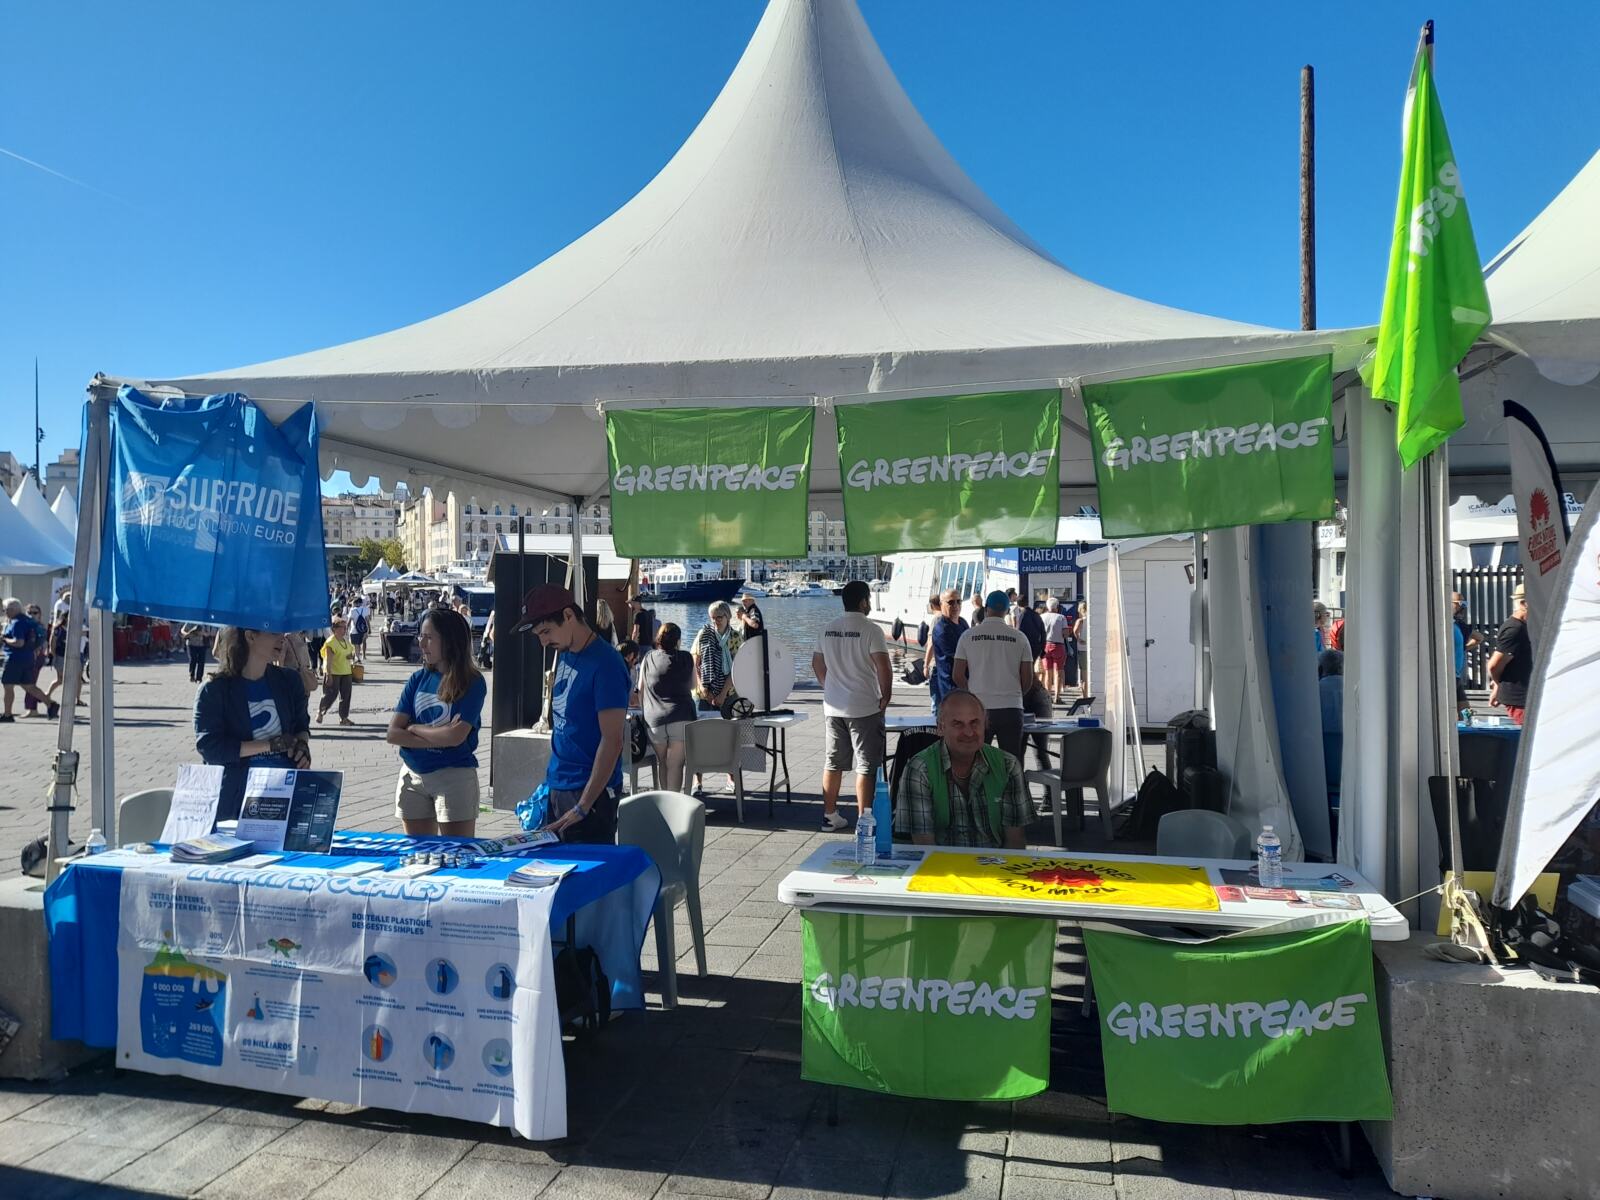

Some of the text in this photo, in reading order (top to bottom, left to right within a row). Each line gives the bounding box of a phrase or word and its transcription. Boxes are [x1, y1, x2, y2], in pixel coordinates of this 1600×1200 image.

[1102, 417, 1328, 470] GREENPEACE
[847, 448, 1056, 491] GREENPEACE
[613, 462, 807, 496] GREENPEACE
[1320, 527, 1334, 539] 329
[1022, 564, 1072, 573] calanques-if.com
[824, 630, 844, 638] FOOTBALL
[996, 635, 1017, 643] MISSION
[352, 913, 433, 929] BOUTEILLE PLASTIQUE,
[365, 923, 393, 932] GESTES
[393, 926, 425, 935] SIMPLES
[811, 973, 1046, 1020] GREENPEACE
[1106, 992, 1368, 1045] GREENPEACE
[252, 1039, 293, 1051] MILLIARDS
